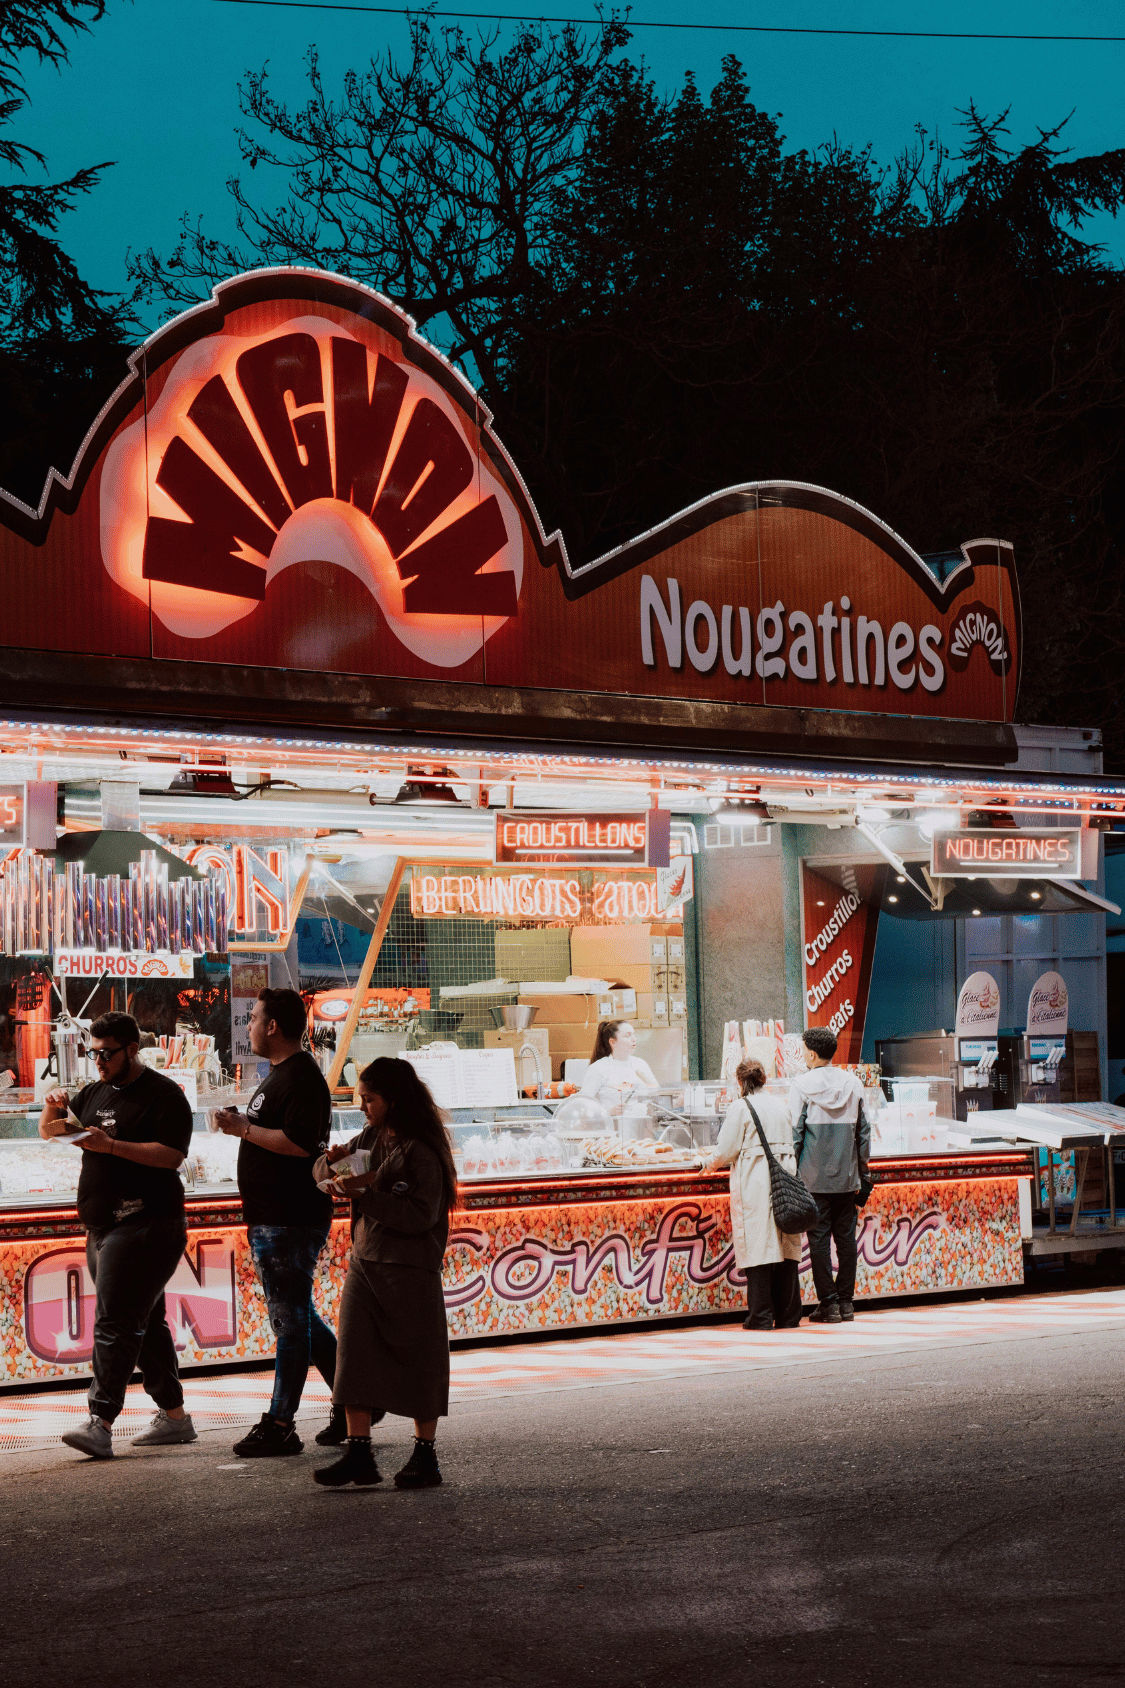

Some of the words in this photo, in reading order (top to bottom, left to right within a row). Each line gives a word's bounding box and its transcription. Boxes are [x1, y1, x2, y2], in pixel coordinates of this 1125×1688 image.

[142, 332, 518, 616] MIGNON
[640, 574, 945, 692] Nougatines
[950, 612, 1007, 661] MIGNON
[503, 822, 646, 848] CROUSTILLONS
[945, 838, 1070, 863] NOUGATINES
[422, 875, 581, 918] BERLINGOTS
[58, 955, 138, 975] CHURROS
[143, 961, 167, 974] MIGNON
[805, 948, 853, 1013] Churros
[961, 991, 980, 1009] Glace
[1032, 990, 1050, 1008] Glace
[826, 998, 855, 1038] gats
